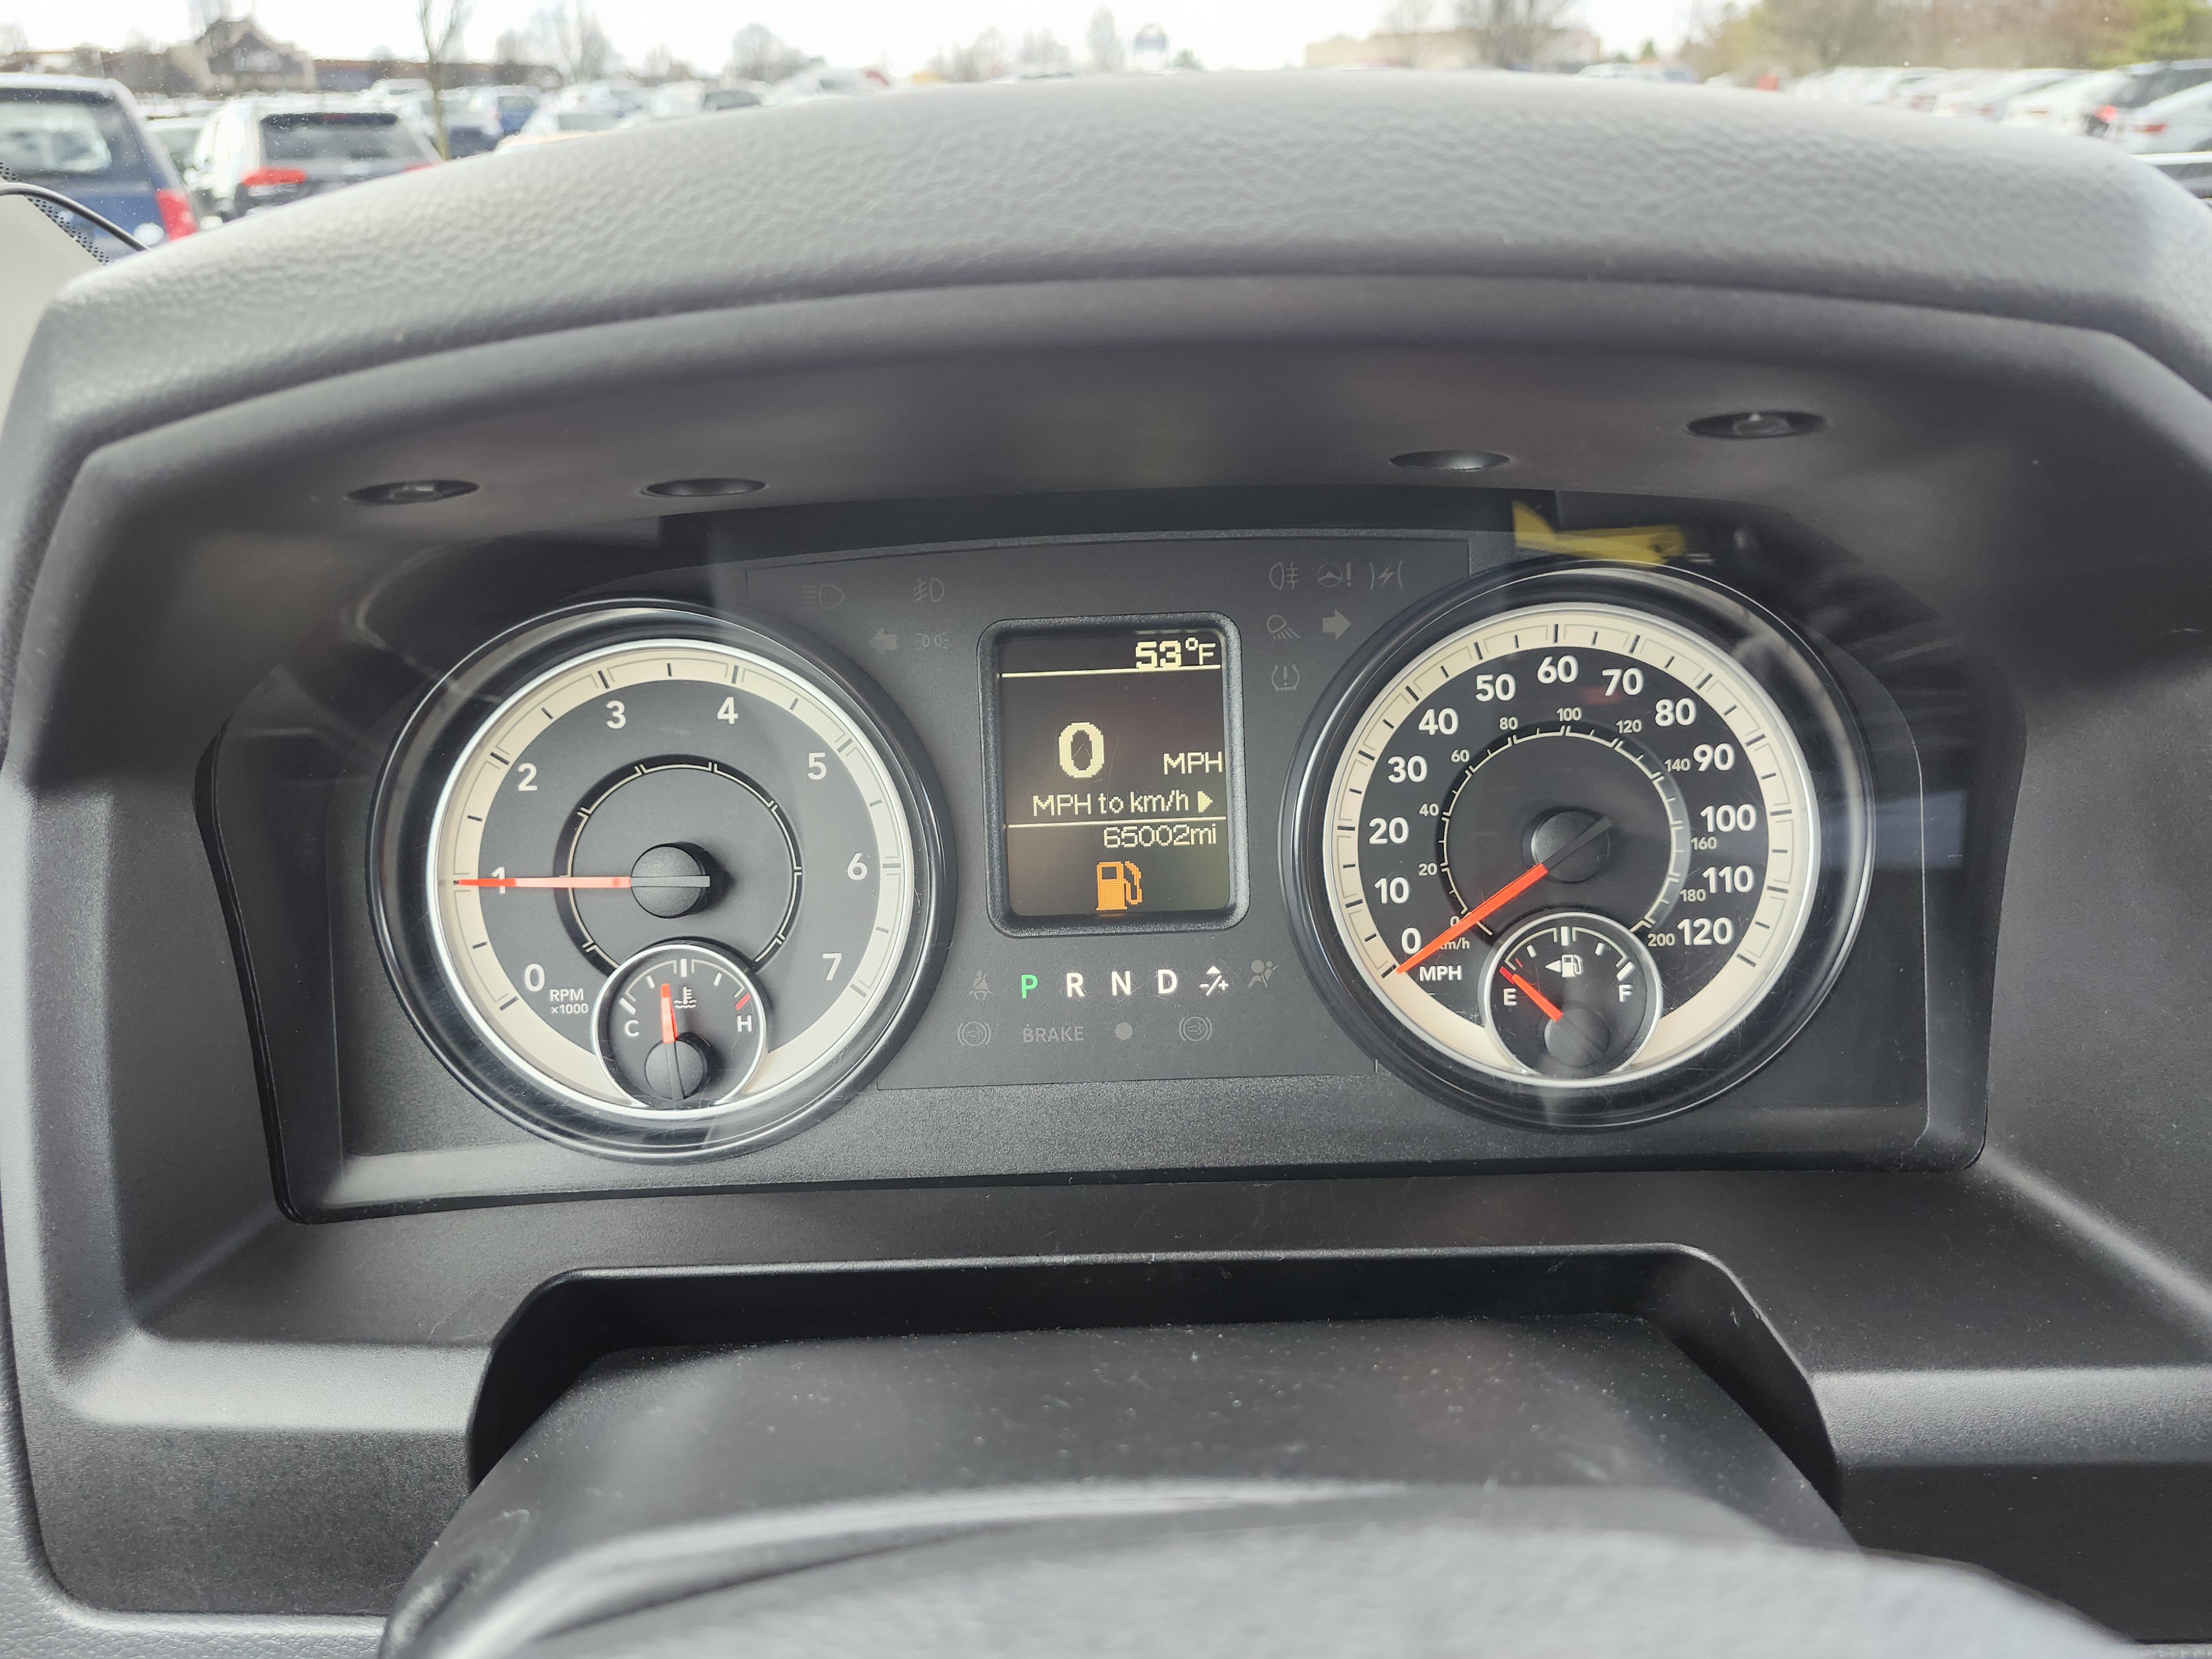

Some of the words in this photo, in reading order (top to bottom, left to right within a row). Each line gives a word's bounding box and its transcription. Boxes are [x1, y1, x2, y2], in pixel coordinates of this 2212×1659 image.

[1537, 655, 1578, 684] 60
[1601, 667, 1644, 697] 70
[1475, 673, 1517, 701] 50
[606, 701, 627, 729] 3
[717, 696, 739, 724] 4
[1418, 707, 1459, 737] 40
[1557, 707, 1582, 722] 100
[1654, 697, 1696, 727] 80
[1499, 717, 1519, 731] 80
[1616, 718, 1642, 734] 120
[1058, 722, 1105, 778] 0
[1164, 752, 1222, 775] MPH
[1451, 748, 1470, 764] 60
[1693, 743, 1734, 773] 90
[517, 763, 538, 792] 2
[807, 752, 828, 780] 5
[1387, 755, 1428, 783] 30
[1665, 756, 1691, 772] 140
[1033, 794, 1092, 816] MPH
[1098, 792, 1124, 814] to
[1130, 790, 1189, 813] km/h
[1419, 803, 1439, 817] 40
[1368, 817, 1409, 845] 20
[1699, 804, 1756, 832] 100
[1104, 823, 1217, 848] 65002mi
[1691, 836, 1717, 851] 160
[847, 852, 868, 880] 6
[1418, 863, 1438, 877] 20
[1702, 865, 1754, 894] 110
[491, 867, 506, 894] 1
[1374, 877, 1410, 904] 10
[1679, 888, 1707, 903] 180
[1402, 927, 1422, 954] 0
[1647, 933, 1676, 948] 200
[1677, 917, 1733, 946] 120
[524, 963, 545, 993] 0
[822, 953, 843, 981] 7
[1419, 965, 1462, 981] MPH
[549, 988, 584, 1001] RPM
[1020, 974, 1038, 999] P
[1066, 972, 1084, 997] R
[1111, 971, 1131, 995] N
[1157, 969, 1177, 994] D
[1503, 988, 1517, 1006] E
[1619, 984, 1632, 1001] F
[624, 1019, 640, 1037] C
[737, 1015, 753, 1032] H
[1023, 1026, 1084, 1043] BRAKE
